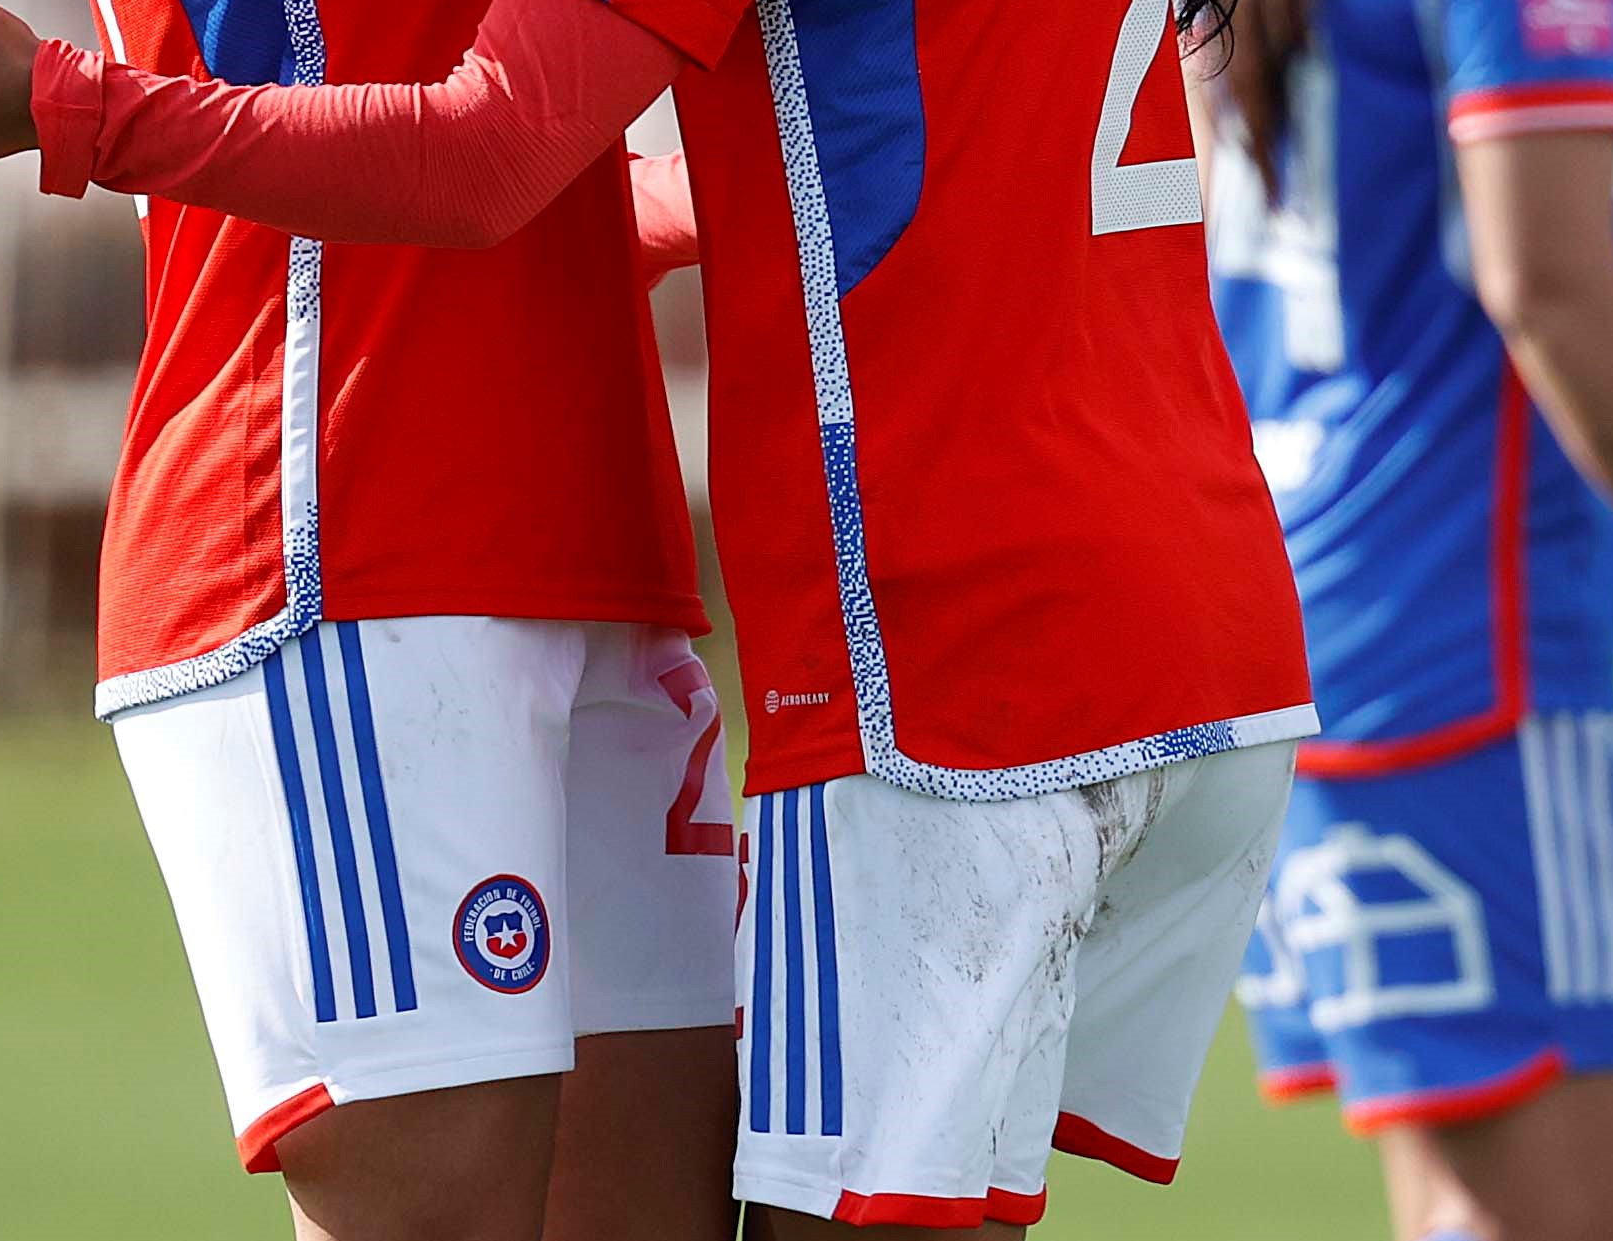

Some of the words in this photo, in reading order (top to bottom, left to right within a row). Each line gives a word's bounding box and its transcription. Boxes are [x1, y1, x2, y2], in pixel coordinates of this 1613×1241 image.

[780, 691, 829, 706] AEROREADY
[657, 659, 734, 857] 2
[464, 887, 501, 942] FEDERACION
[507, 888, 517, 899] DE
[520, 895, 541, 929] FUTBOL
[494, 968, 505, 980] DE
[512, 962, 534, 980] CHILE
